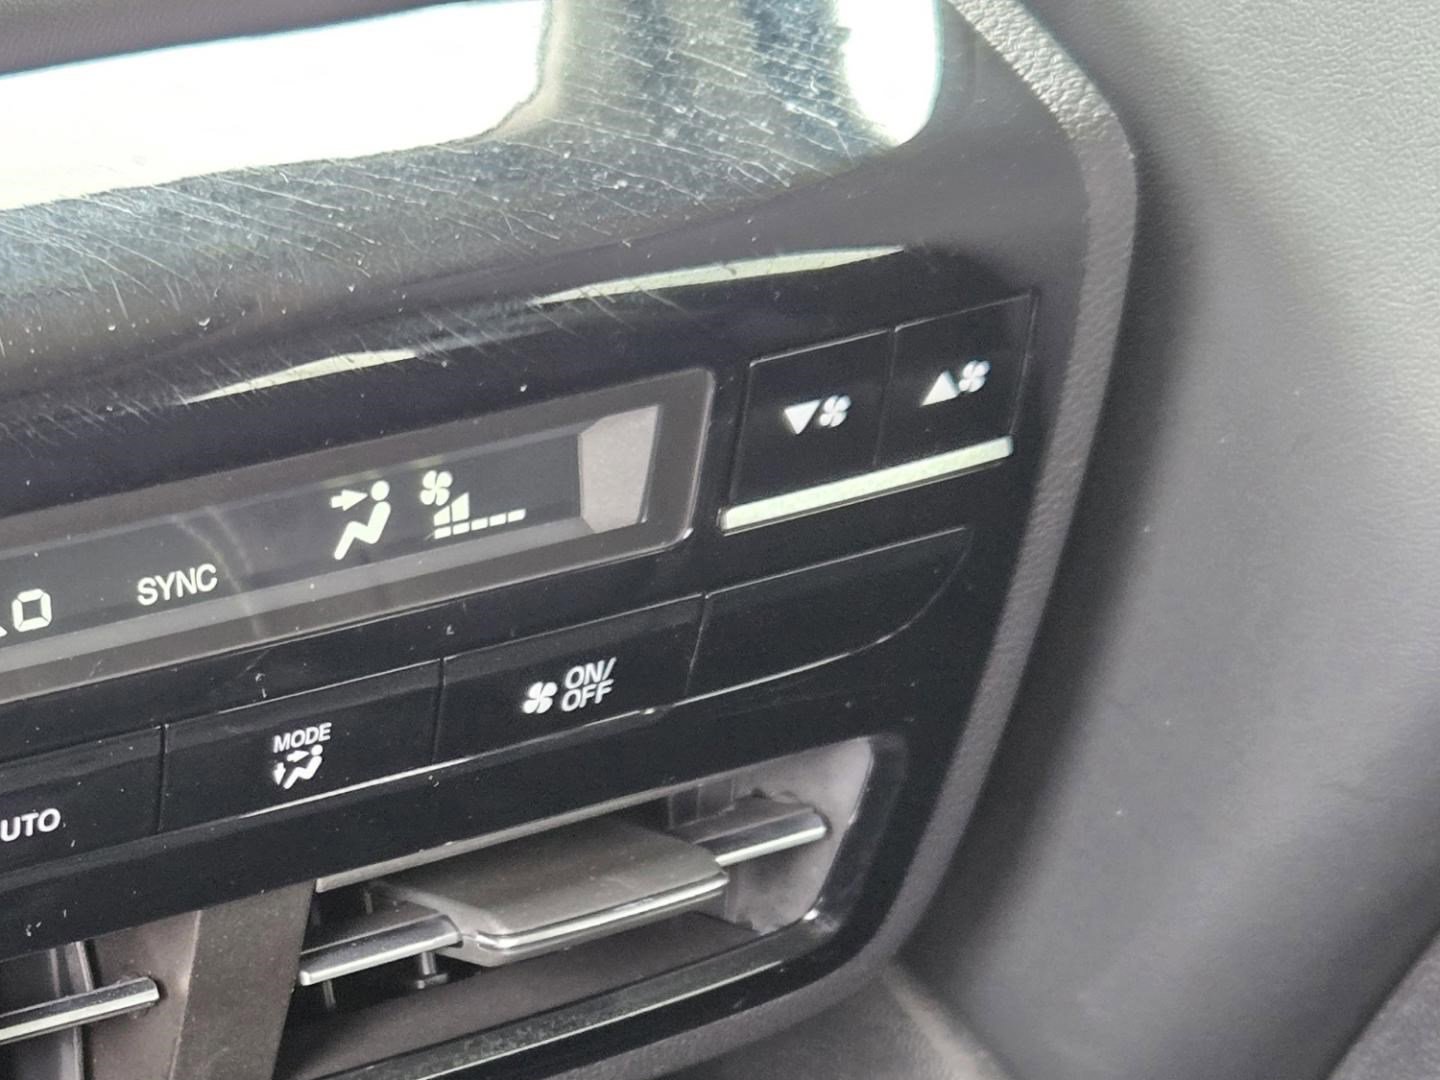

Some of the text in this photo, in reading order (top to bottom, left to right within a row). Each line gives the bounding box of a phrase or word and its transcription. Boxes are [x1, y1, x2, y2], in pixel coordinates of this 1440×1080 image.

[137, 563, 217, 605] SYNC
[564, 657, 617, 690] ON/
[561, 679, 615, 712] OFF
[273, 722, 332, 754] MODE
